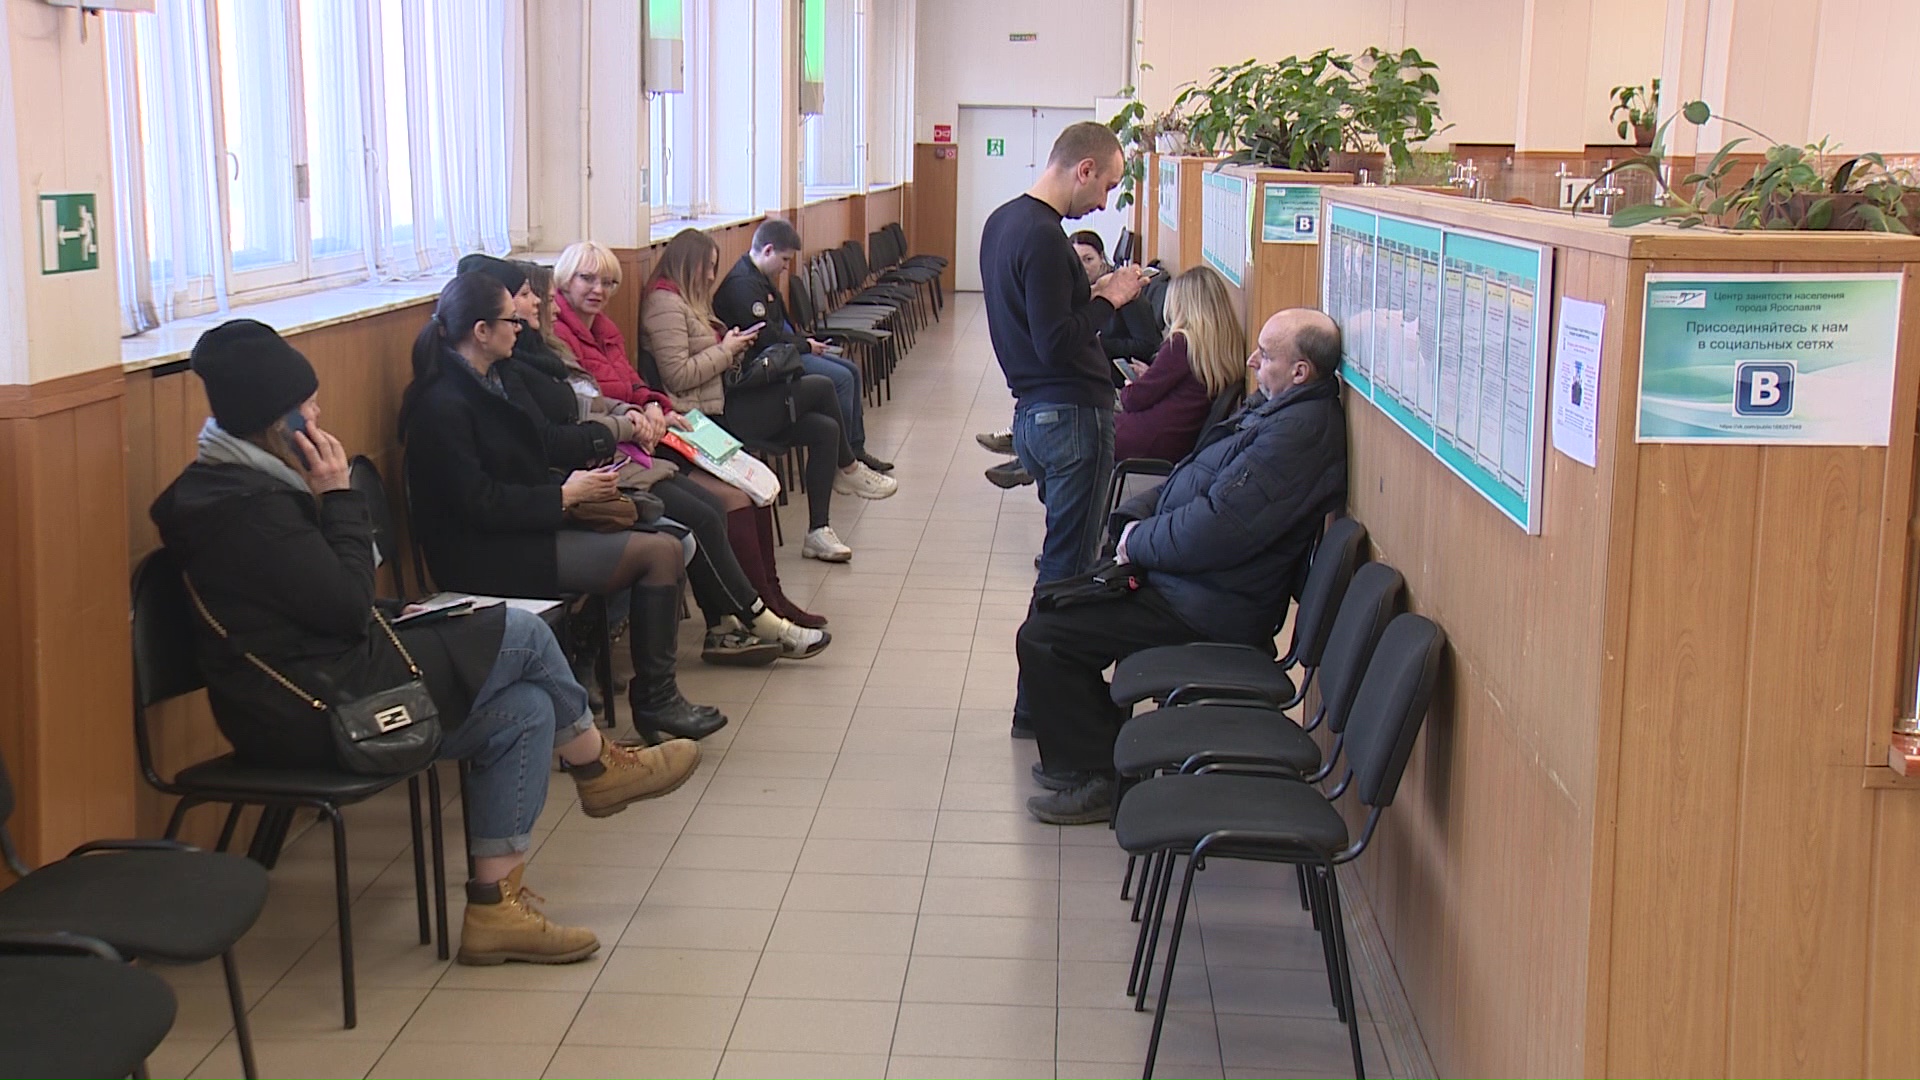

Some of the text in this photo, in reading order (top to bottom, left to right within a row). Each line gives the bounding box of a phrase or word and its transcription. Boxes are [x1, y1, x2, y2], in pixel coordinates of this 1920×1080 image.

[1714, 292, 1845, 301] Центр занятости населения
[1735, 303, 1822, 313] города Ярославля
[1686, 321, 1849, 335] Присоединяйтесь к нам
[1698, 340, 1834, 351] в социальных сетях
